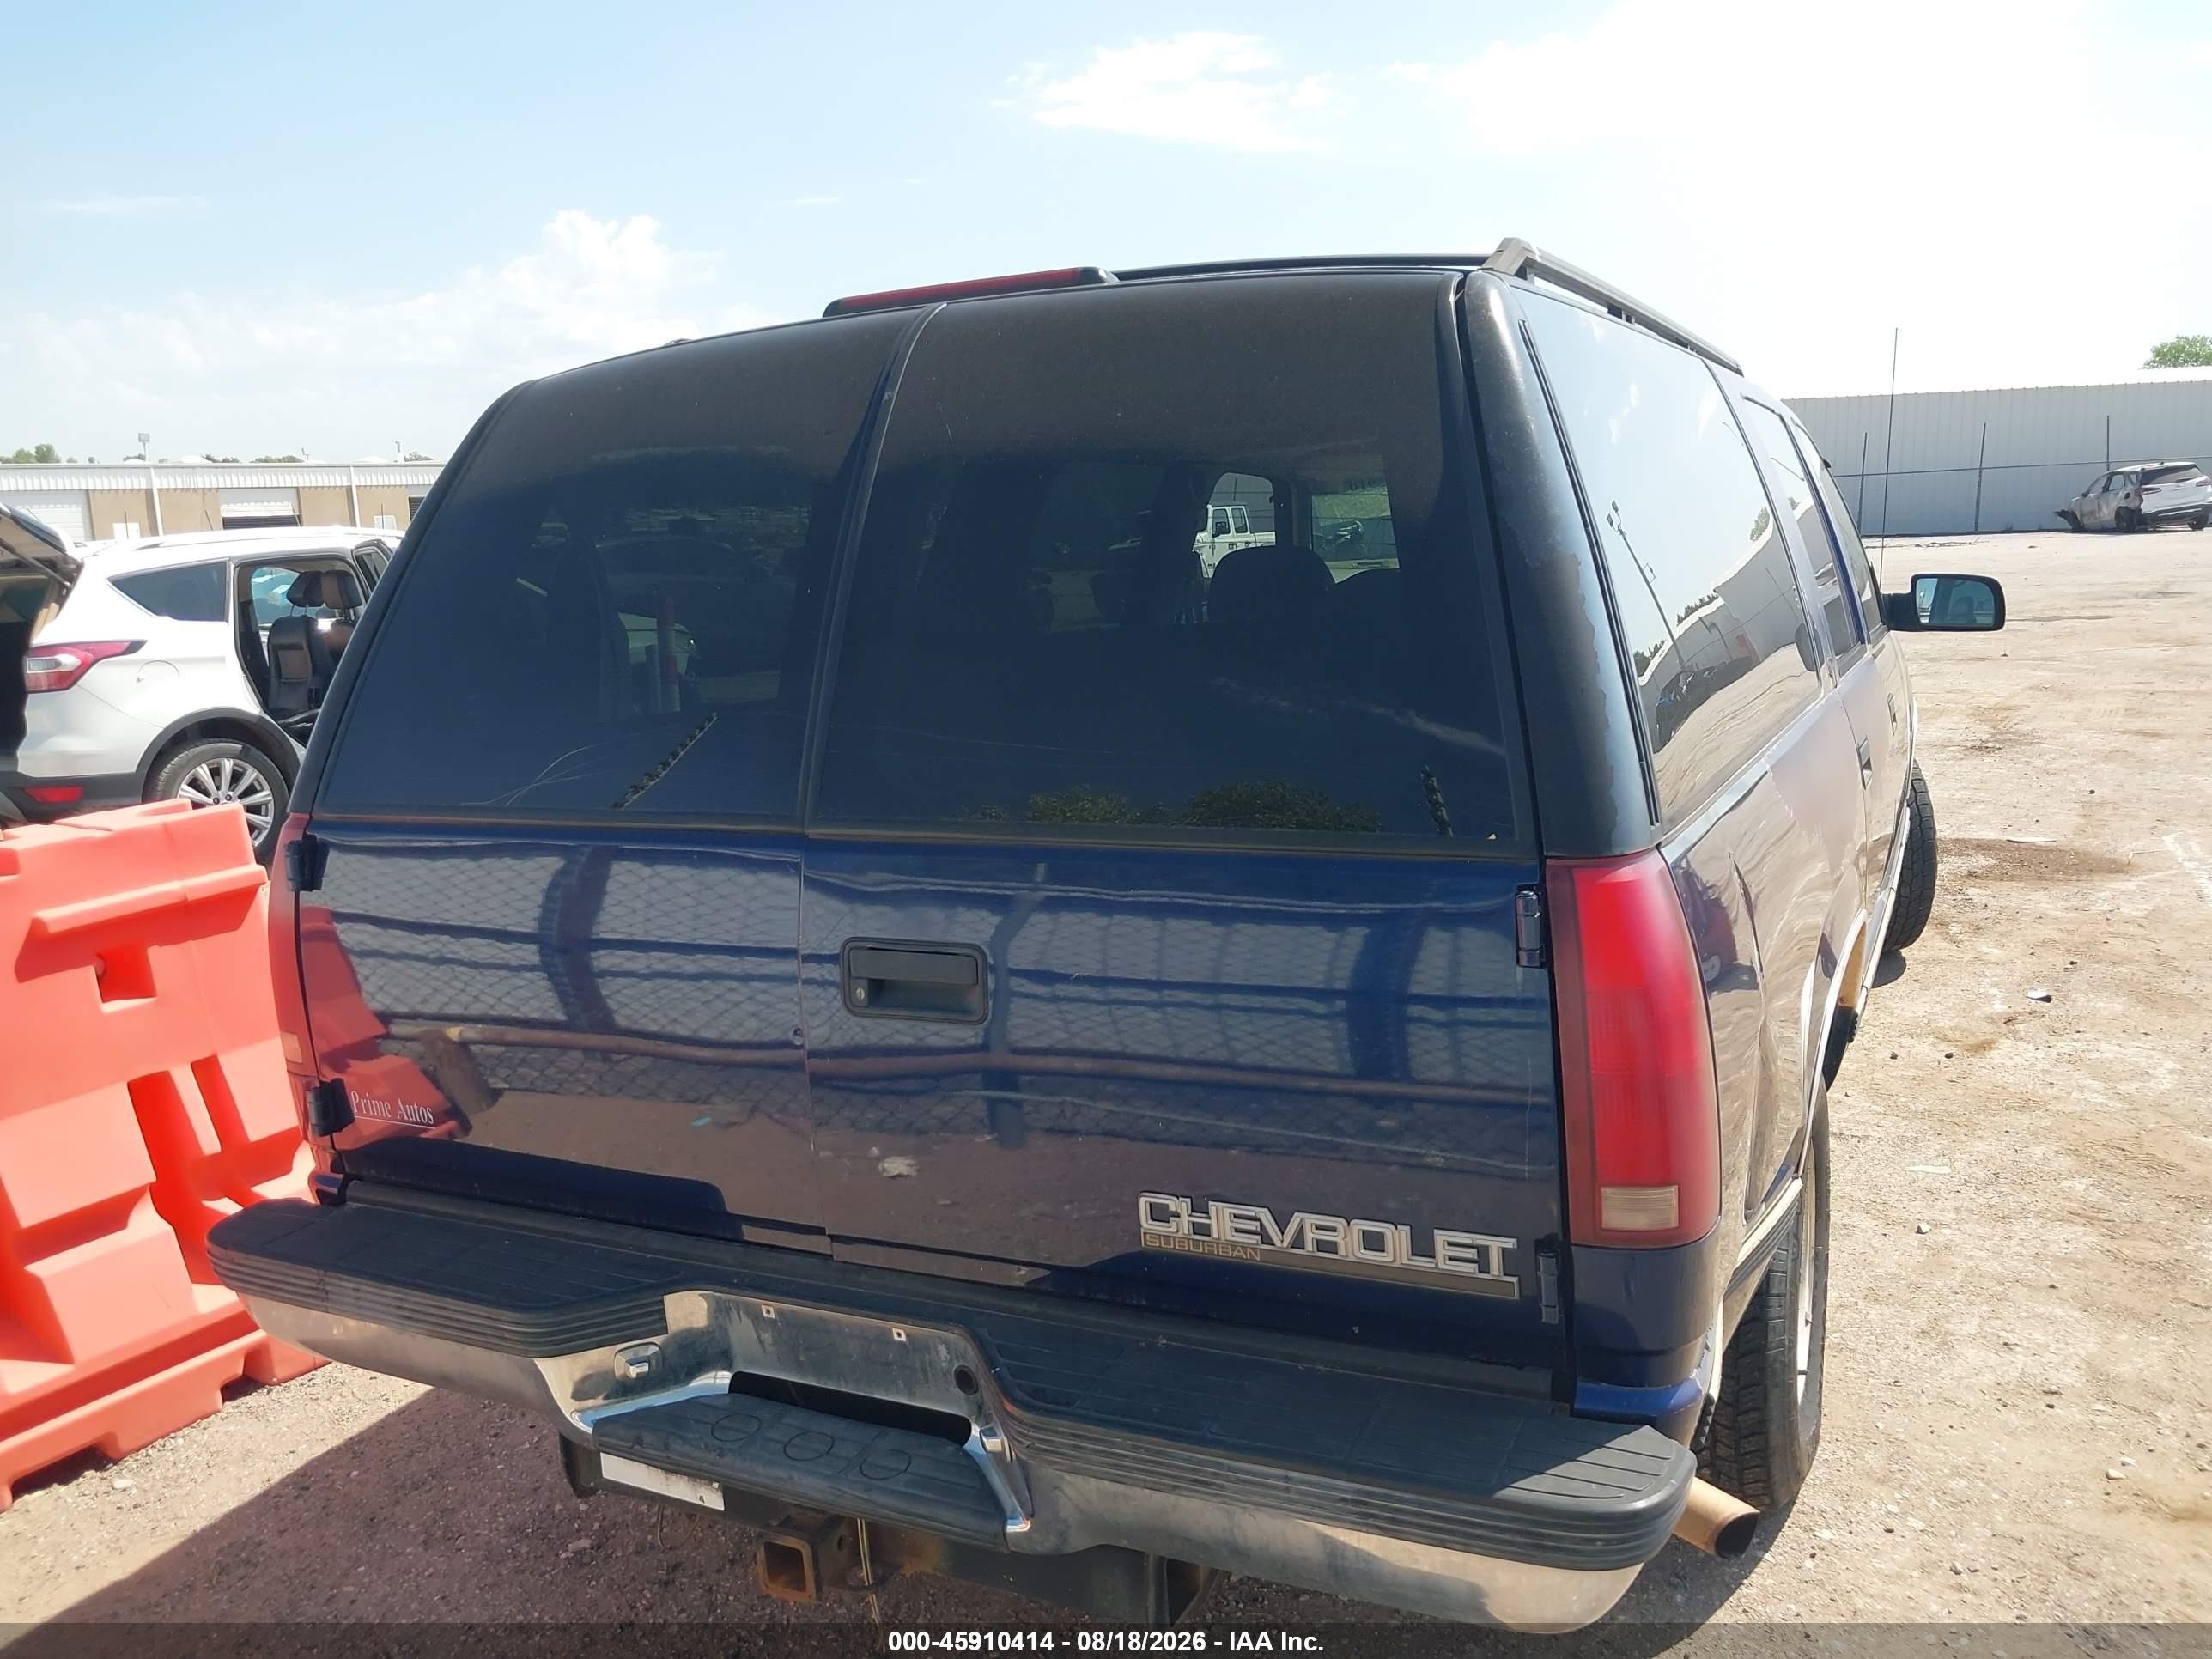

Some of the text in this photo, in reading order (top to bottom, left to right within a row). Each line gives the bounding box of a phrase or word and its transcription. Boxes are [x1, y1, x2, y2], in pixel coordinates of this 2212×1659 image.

[350, 1091, 434, 1125] Prime Autos
[1139, 1191, 1519, 1278] CHEVROLET
[1146, 1233, 1261, 1261] SUBURBAN
